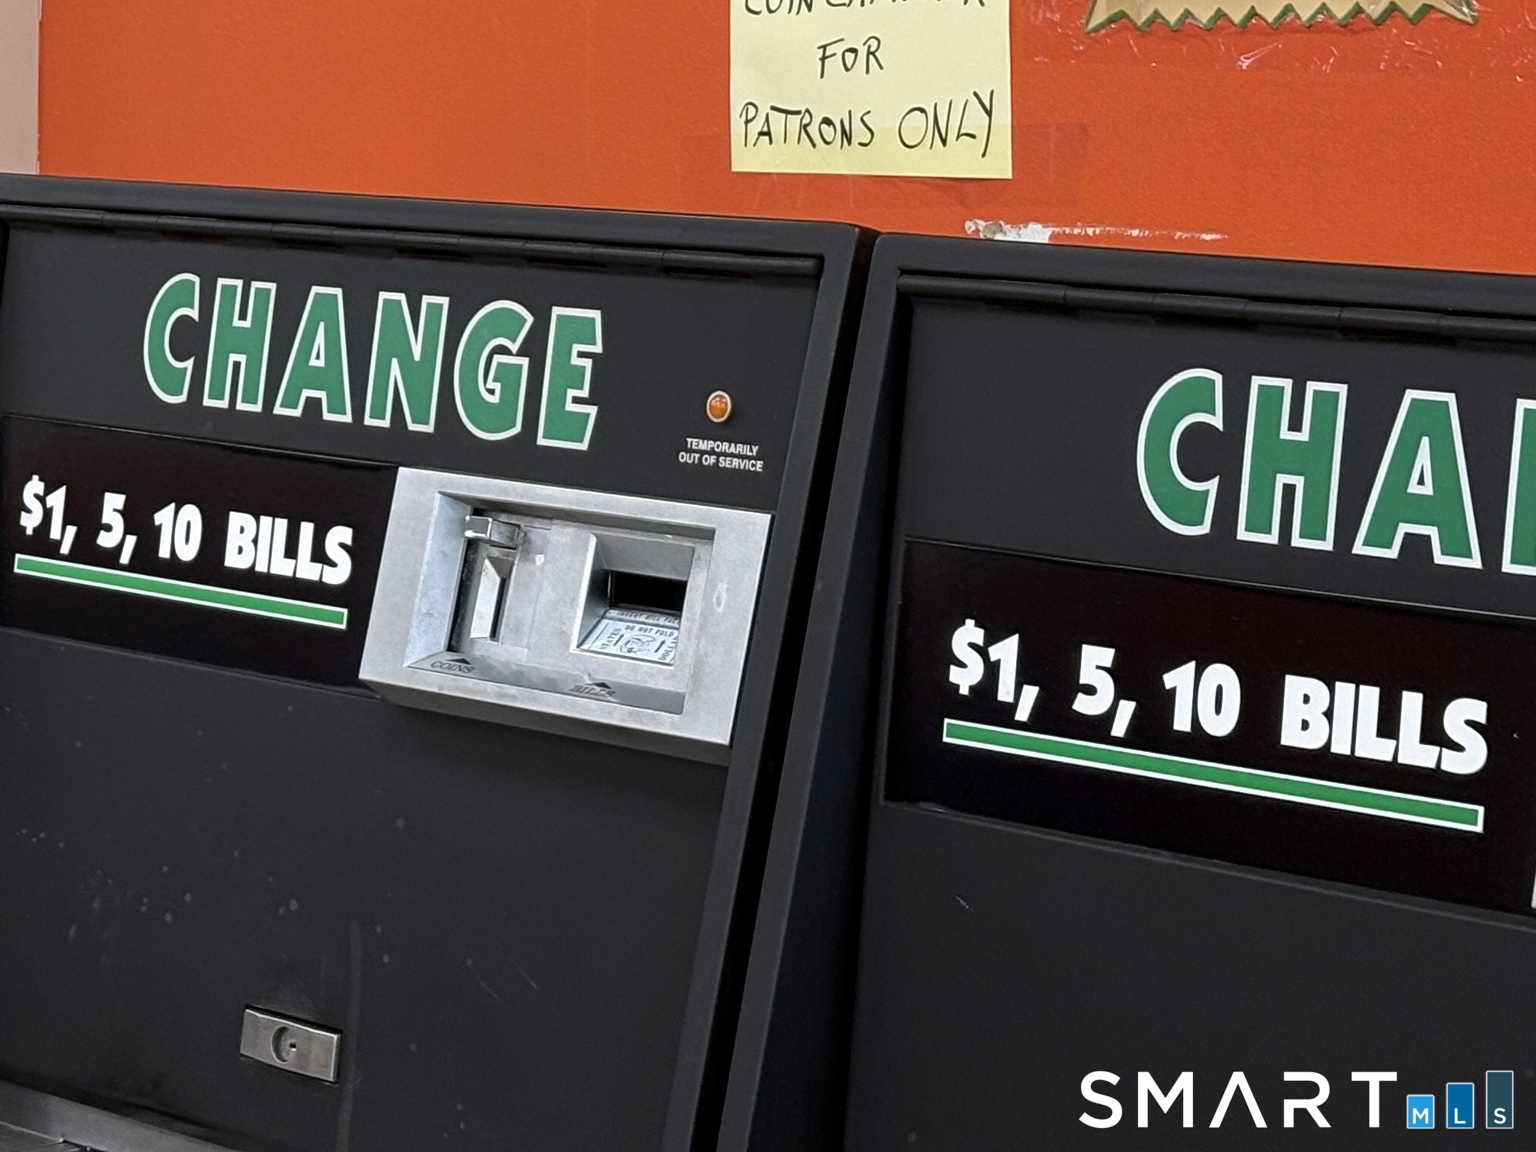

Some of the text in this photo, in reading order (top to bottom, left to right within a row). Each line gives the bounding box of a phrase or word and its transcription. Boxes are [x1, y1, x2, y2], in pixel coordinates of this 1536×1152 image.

[816, 35, 884, 79] FOR
[739, 89, 995, 159] PATRONS ONLY
[143, 273, 603, 450] CHANGE
[678, 451, 764, 472] OUT OF SERVICE
[685, 437, 760, 457] TEMPORARILY
[1136, 367, 1536, 575] CHA
[19, 474, 354, 586] $1, 5, 10 BILLS
[625, 624, 635, 632] DO
[654, 629, 675, 637] FOLD
[430, 661, 475, 674] COINS
[569, 684, 616, 698] BILLS
[948, 619, 1489, 776] $1, 5, 10 BILLS
